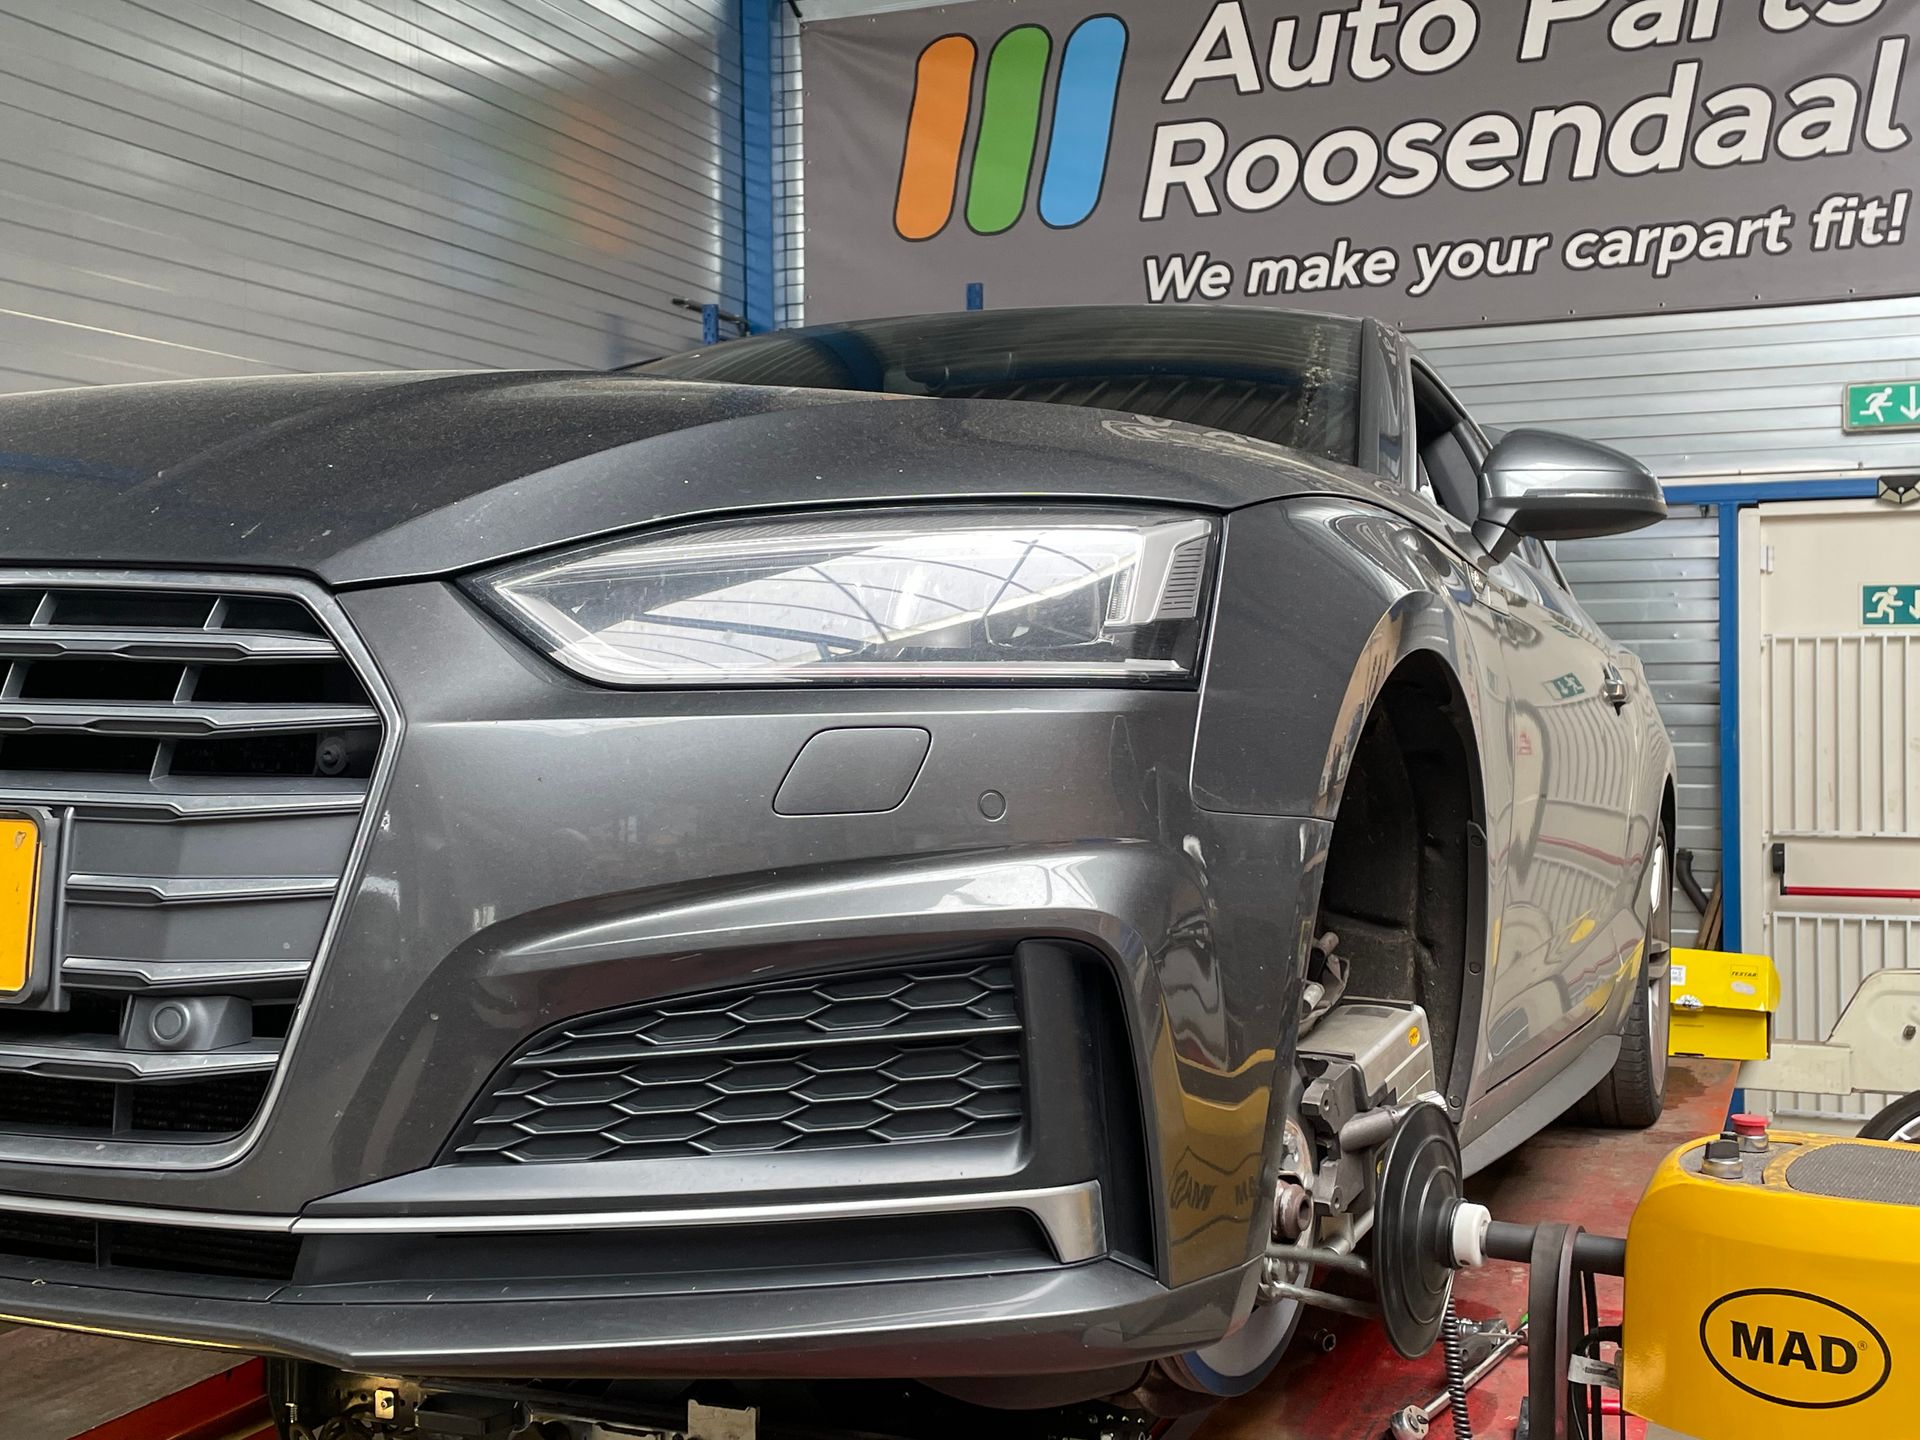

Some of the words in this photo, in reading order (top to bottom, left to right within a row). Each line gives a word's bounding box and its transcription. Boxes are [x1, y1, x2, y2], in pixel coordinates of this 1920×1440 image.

[1163, 0, 1479, 103] Auto
[1141, 36, 1909, 220] Roosendaal
[1146, 254, 1232, 302] We
[1246, 238, 1397, 295] make
[1409, 230, 1549, 295] your
[1564, 207, 1792, 277] carpart
[1811, 191, 1909, 250] fit!
[1730, 1320, 1858, 1375] MAD
